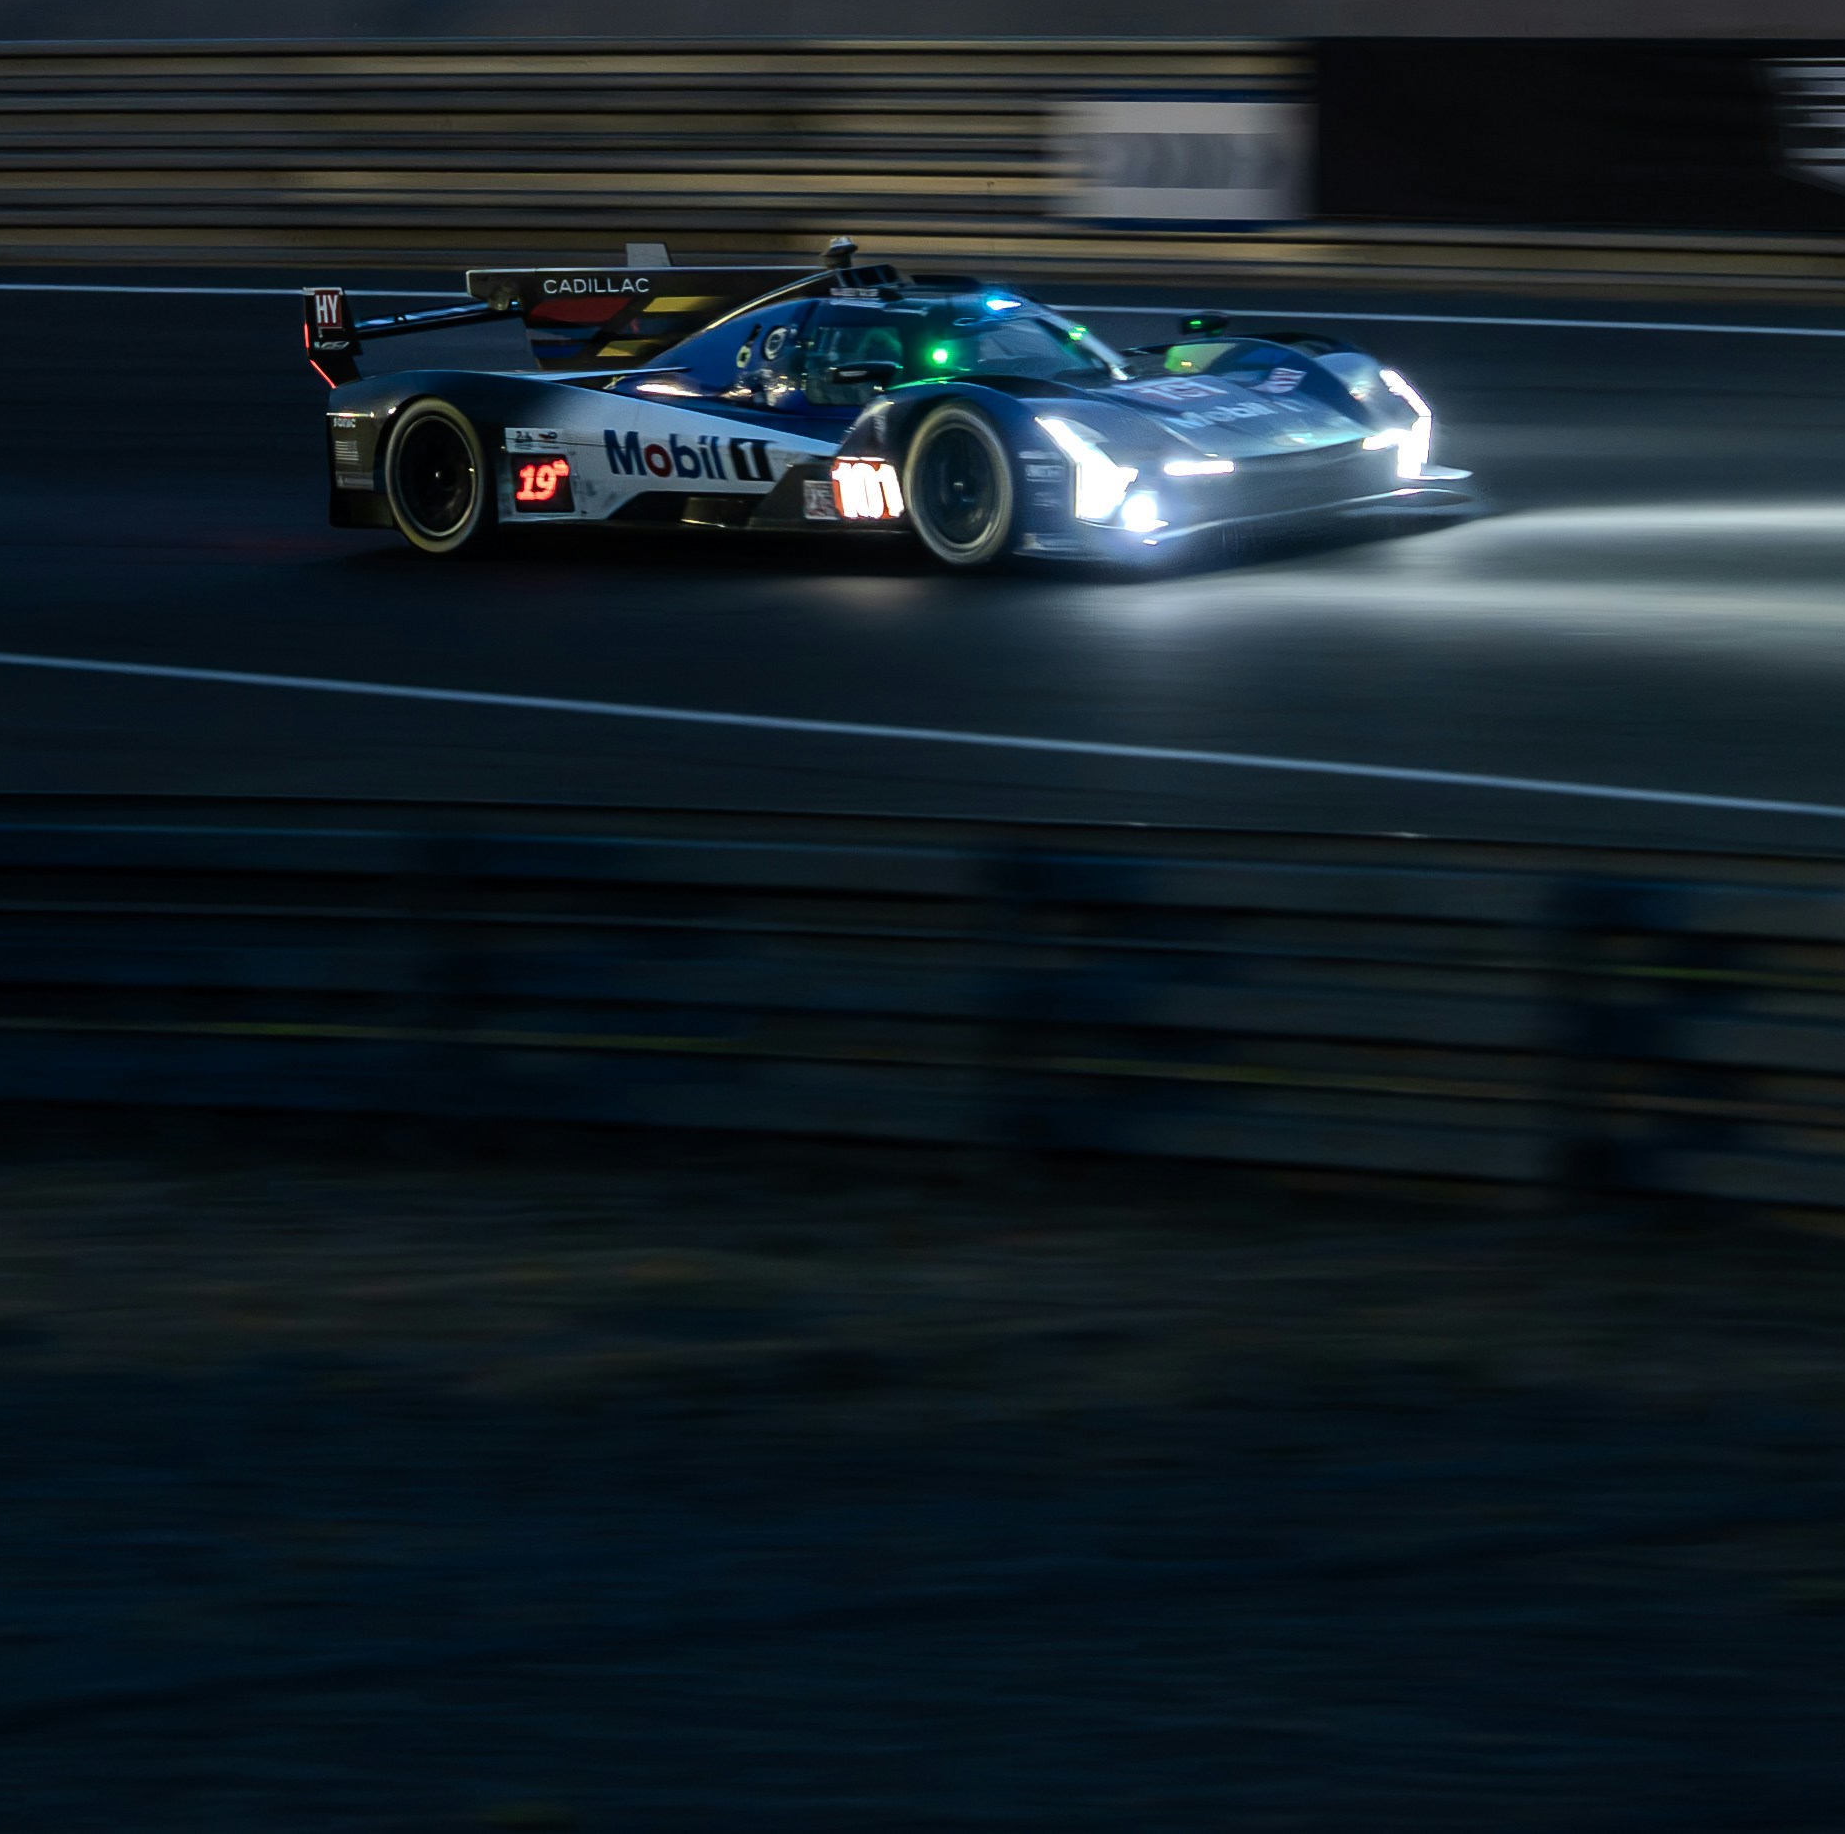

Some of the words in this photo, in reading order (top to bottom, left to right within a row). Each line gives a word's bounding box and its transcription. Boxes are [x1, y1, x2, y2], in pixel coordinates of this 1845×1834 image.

[542, 277, 650, 294] CADILLAC
[315, 294, 339, 324] HY
[604, 429, 728, 480] Mobil
[832, 462, 904, 518] 101
